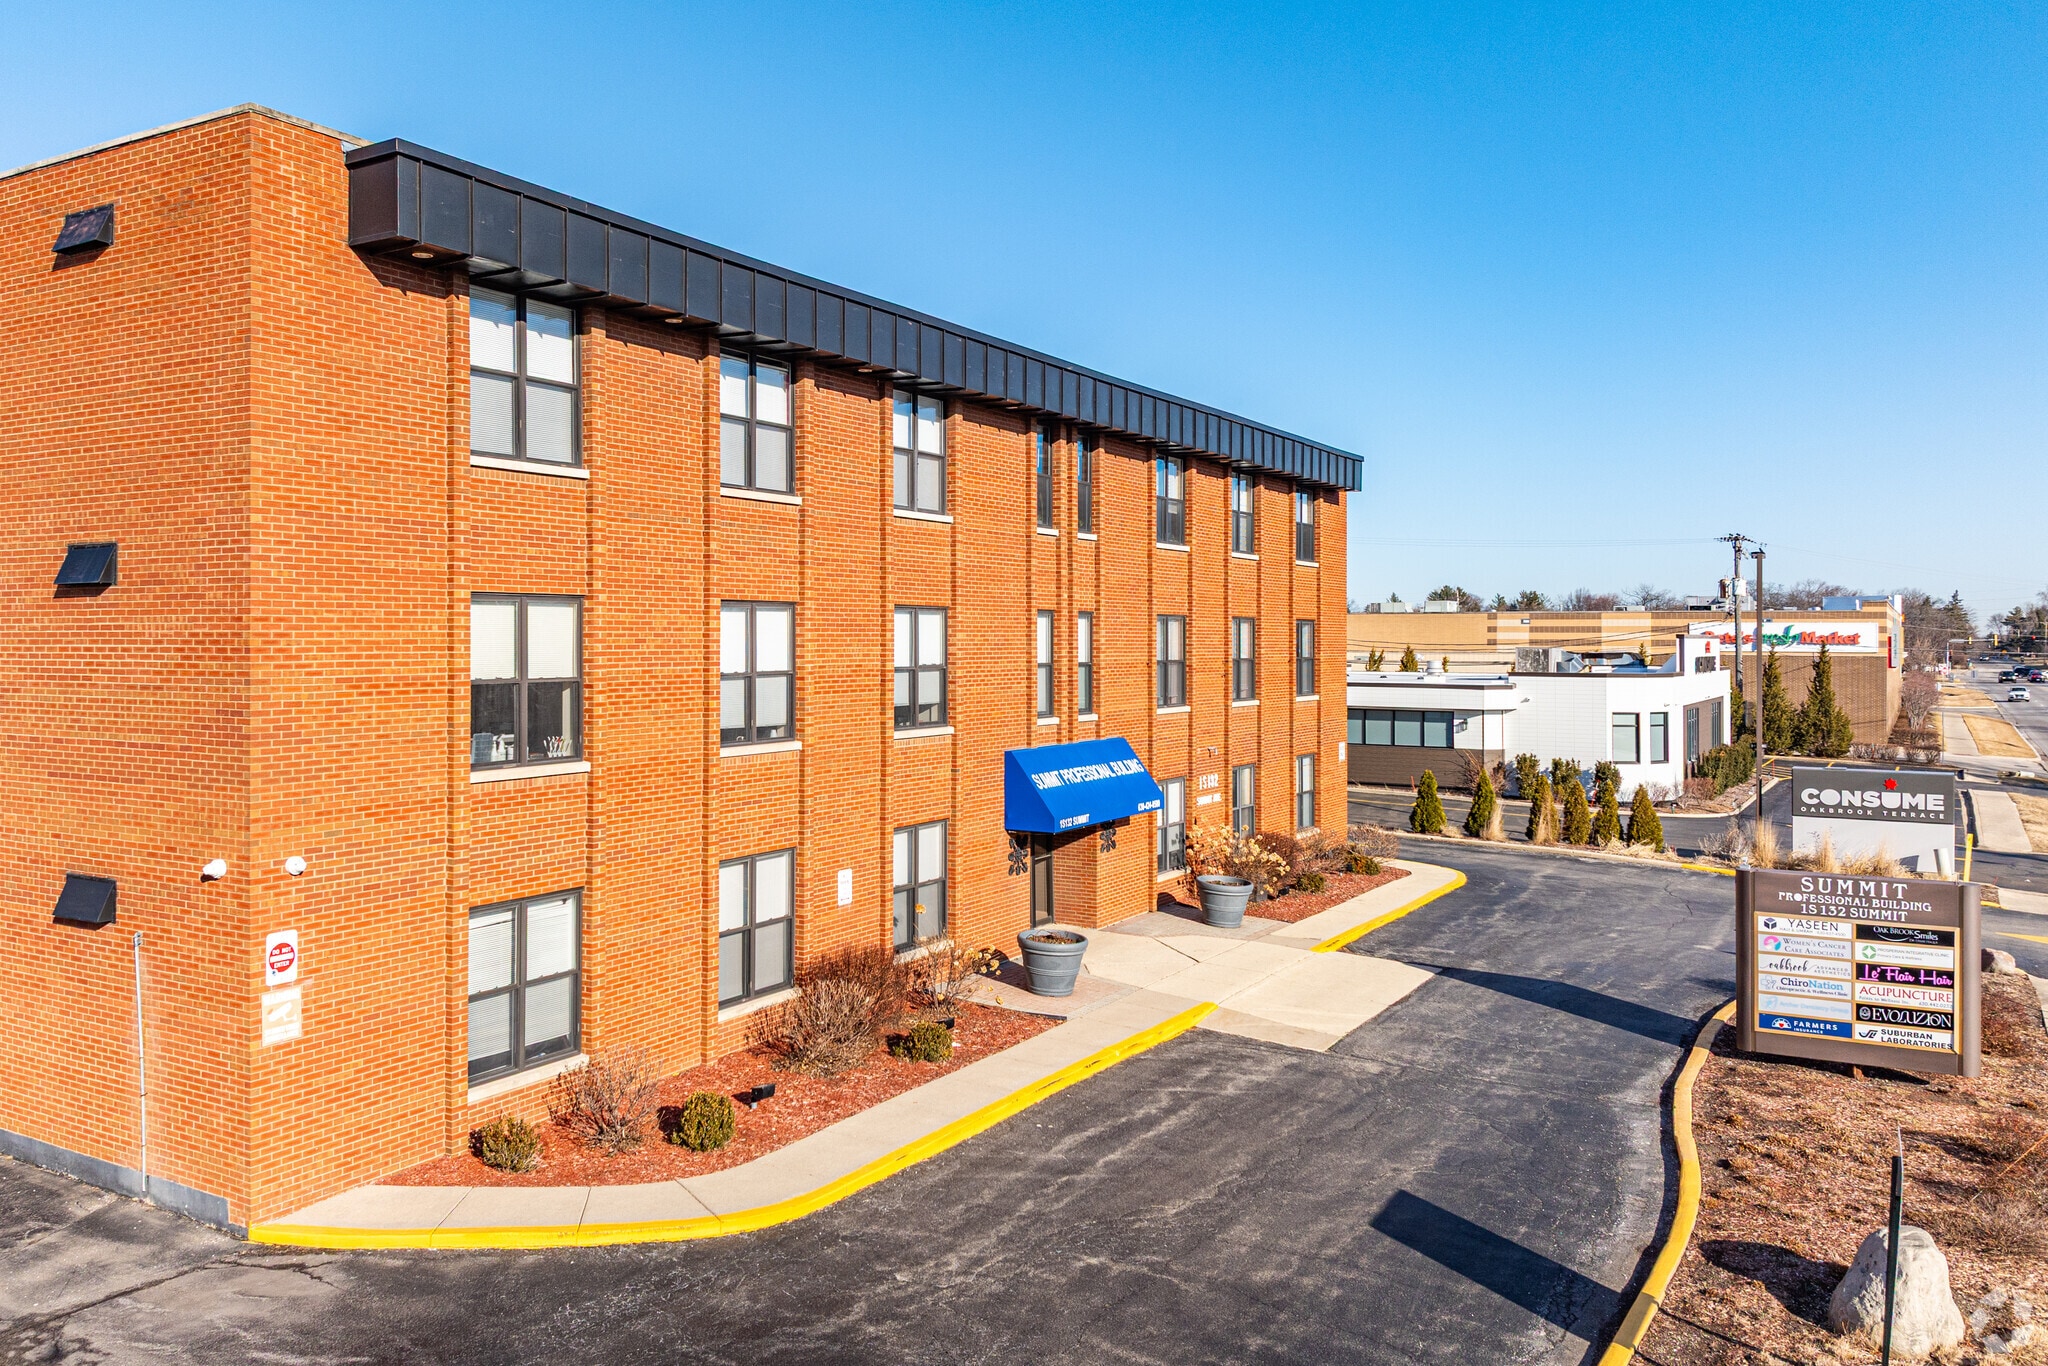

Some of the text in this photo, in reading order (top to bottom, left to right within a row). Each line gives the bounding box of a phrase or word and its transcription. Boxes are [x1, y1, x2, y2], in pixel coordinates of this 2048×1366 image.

[1801, 631, 1860, 645] Market
[1031, 758, 1145, 790] SUMMIT PROFESSIONAL BUILDING
[1800, 787, 1945, 811] CONSUME
[1800, 806, 1945, 820] OAKBROOK TERRACE
[1800, 876, 1908, 899] SUMMIT
[1778, 891, 1932, 912] PROFESSIONAL BUILDING
[1849, 907, 1908, 922] SUMMIT
[1787, 918, 1839, 932] YASEEN
[1873, 925, 1889, 934] OAK
[1914, 930, 1939, 941] Smiles
[1782, 937, 1847, 950] WOMEN'S CANCER
[1784, 945, 1845, 957] CARE ASSOCIATES
[273, 960, 290, 968] ENTER
[1814, 969, 1851, 977] AESTHETICS
[1880, 966, 1915, 982] Flair
[1918, 969, 1953, 986] Hair
[1780, 977, 1844, 991] ChiroNation
[1859, 986, 1953, 1003] ACUPUNCTURE
[1793, 1020, 1838, 1031] FARMERS
[1880, 1028, 1933, 1040] SUBURBAN
[1880, 1036, 1953, 1050] LABORATORIES
